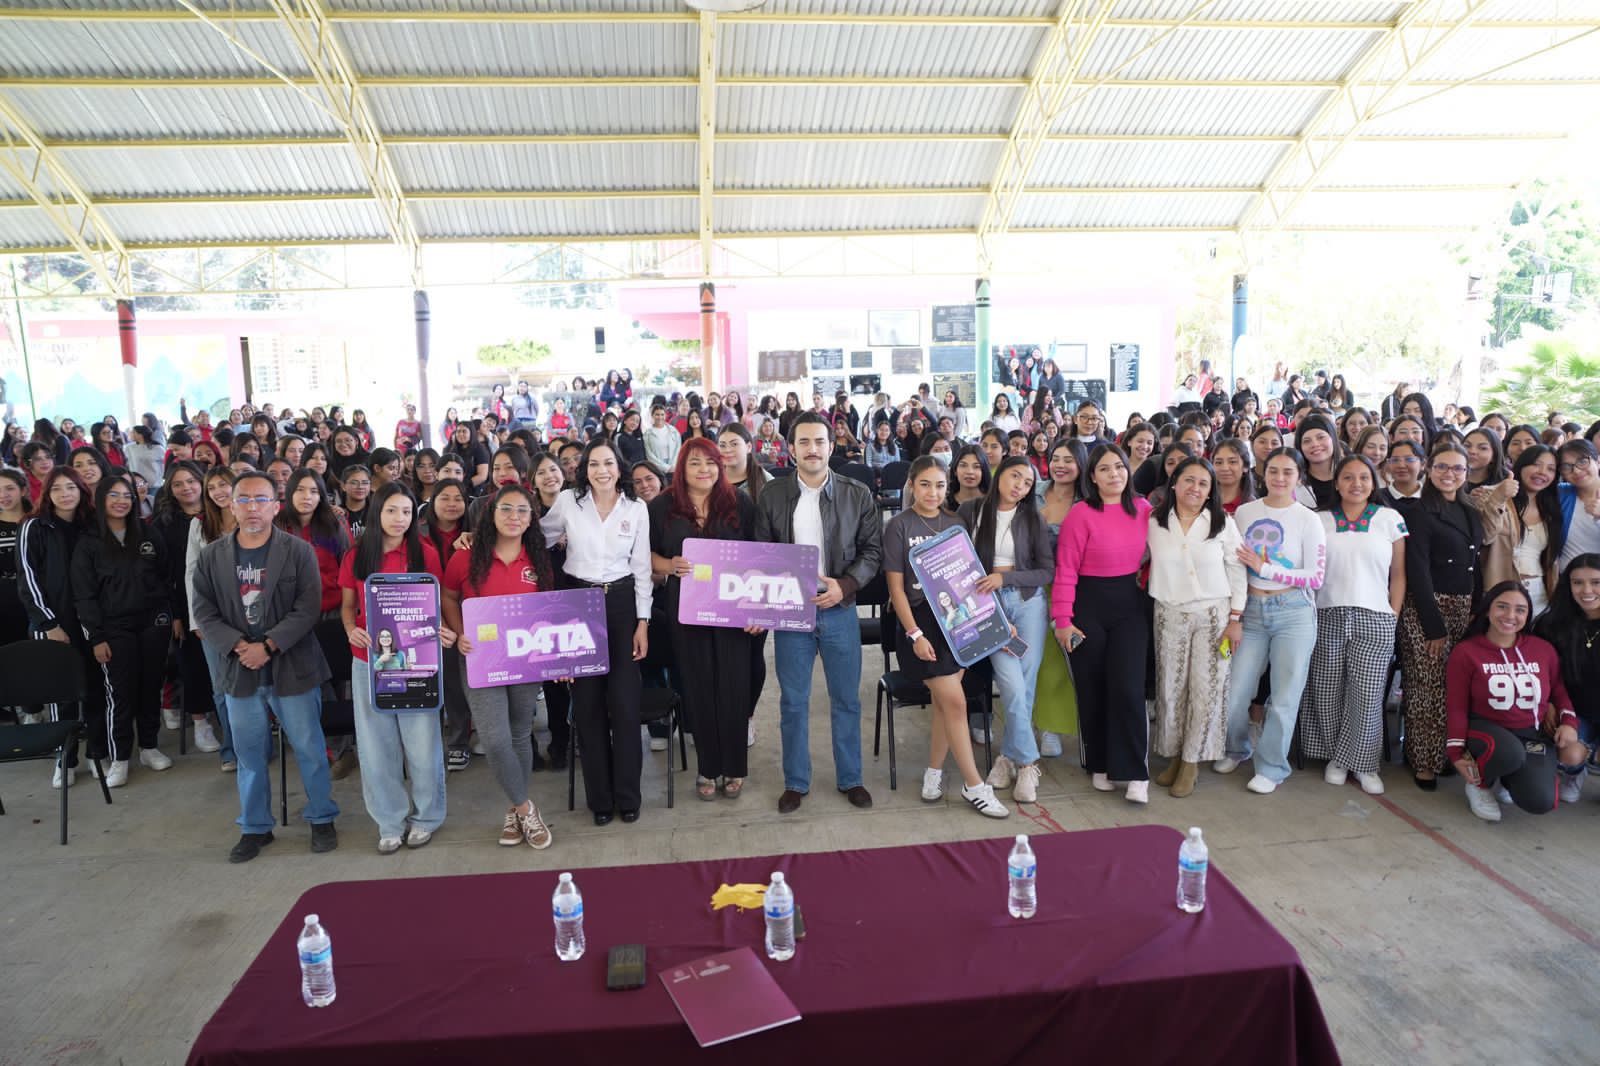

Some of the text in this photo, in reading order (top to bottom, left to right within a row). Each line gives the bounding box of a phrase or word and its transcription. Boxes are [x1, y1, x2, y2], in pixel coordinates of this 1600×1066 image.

[719, 573, 804, 605] D4TA
[382, 607, 424, 615] INTERNET
[393, 614, 428, 622] GRATIS?
[506, 621, 596, 657] D4TA
[1488, 673, 1541, 710] 99
